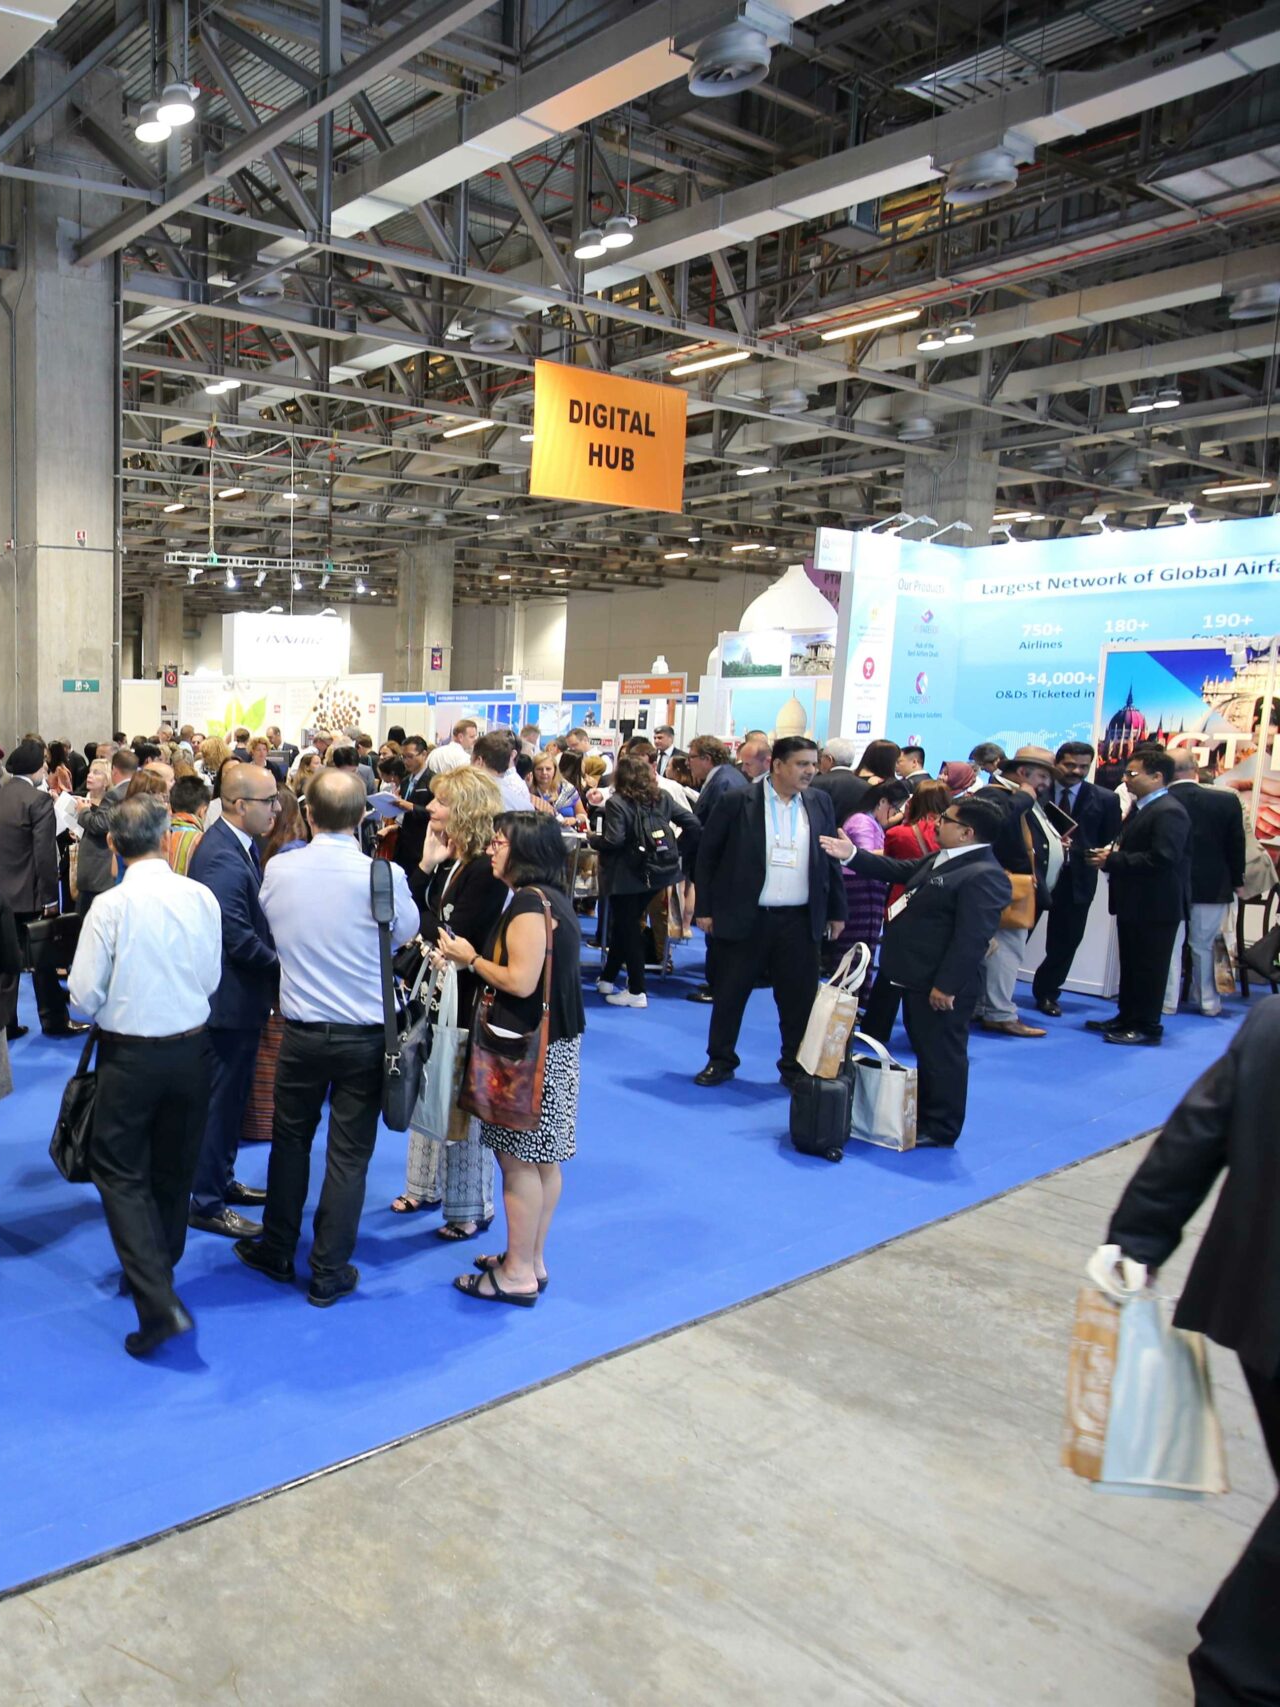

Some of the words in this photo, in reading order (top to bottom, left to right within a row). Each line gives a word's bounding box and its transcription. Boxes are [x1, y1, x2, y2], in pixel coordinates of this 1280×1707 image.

[569, 399, 655, 437] DIGITAL
[588, 442, 634, 471] HUB
[898, 578, 912, 592] Our
[982, 580, 1041, 597] Largest
[1048, 572, 1127, 589] Network
[1134, 569, 1153, 583] of
[1160, 563, 1227, 581] Global
[1022, 623, 1063, 637] 750+
[1104, 618, 1149, 633] 180+
[1202, 613, 1254, 629] 190+
[1019, 640, 1063, 651] Airlines
[1026, 671, 1096, 688] 34,000+
[996, 690, 1027, 700] O&Ds
[1032, 688, 1081, 699] Ticketed
[1084, 688, 1096, 699] in
